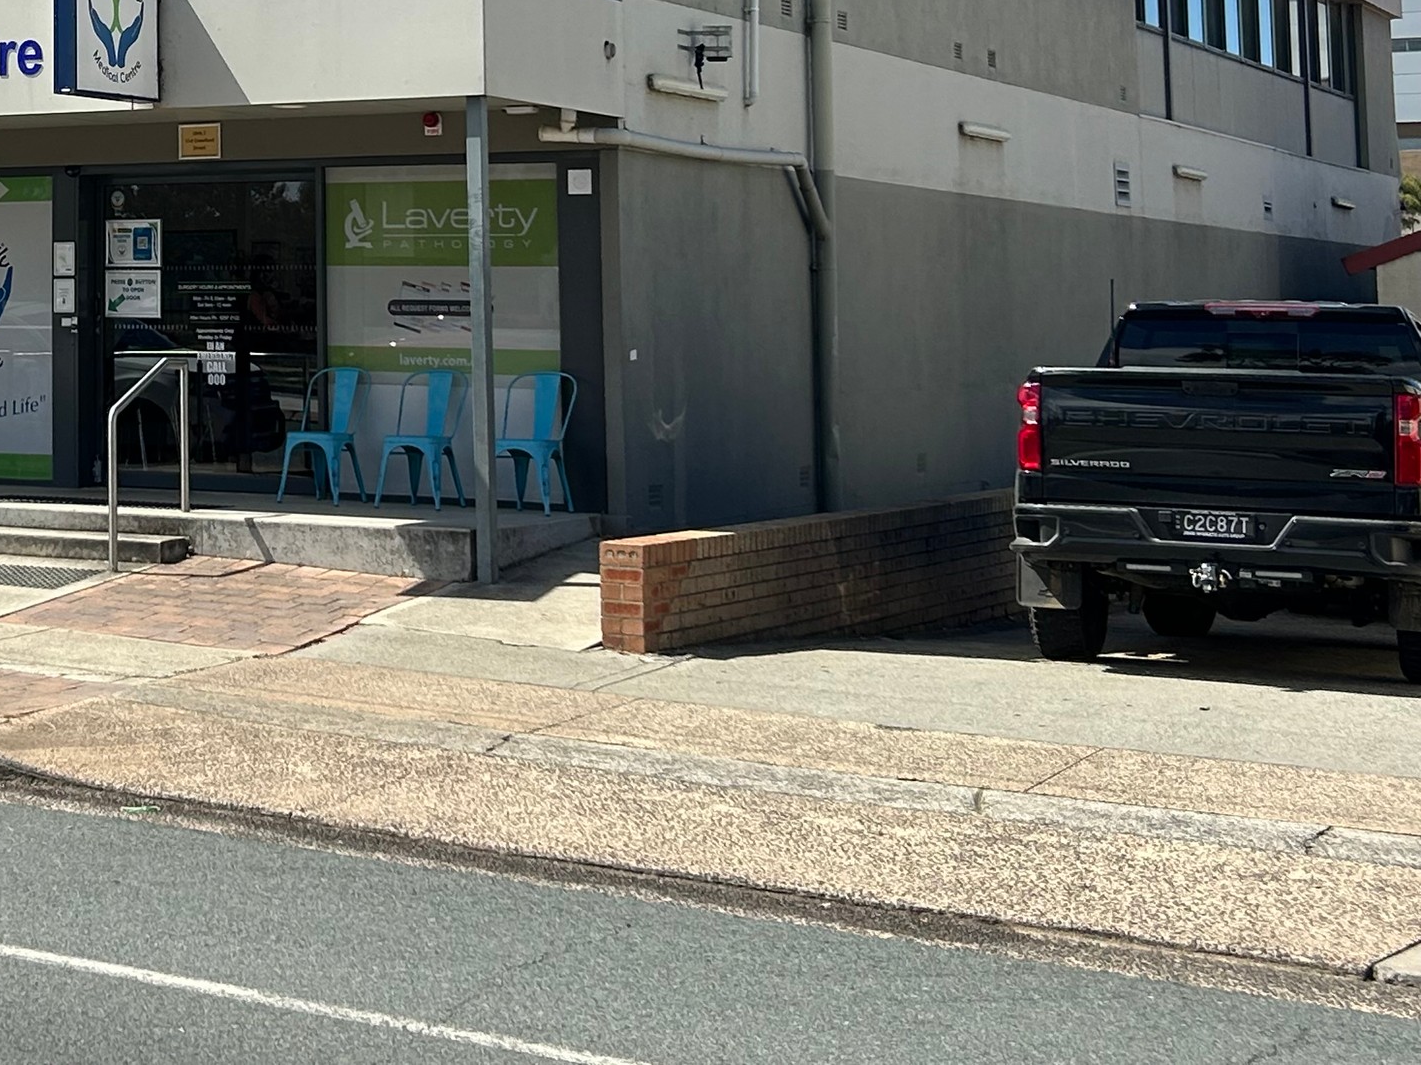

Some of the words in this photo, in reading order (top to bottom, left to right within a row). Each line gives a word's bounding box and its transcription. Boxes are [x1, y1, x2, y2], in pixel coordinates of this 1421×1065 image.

[93, 49, 119, 83] Medical
[120, 60, 142, 83] Centre
[206, 361, 227, 373] CALL
[207, 373, 226, 385] 000
[12, 394, 47, 416] Life"
[1063, 409, 1375, 435] CHEVROLET
[1050, 459, 1130, 468] SILVERADO
[1183, 514, 1249, 534] C2C87T
